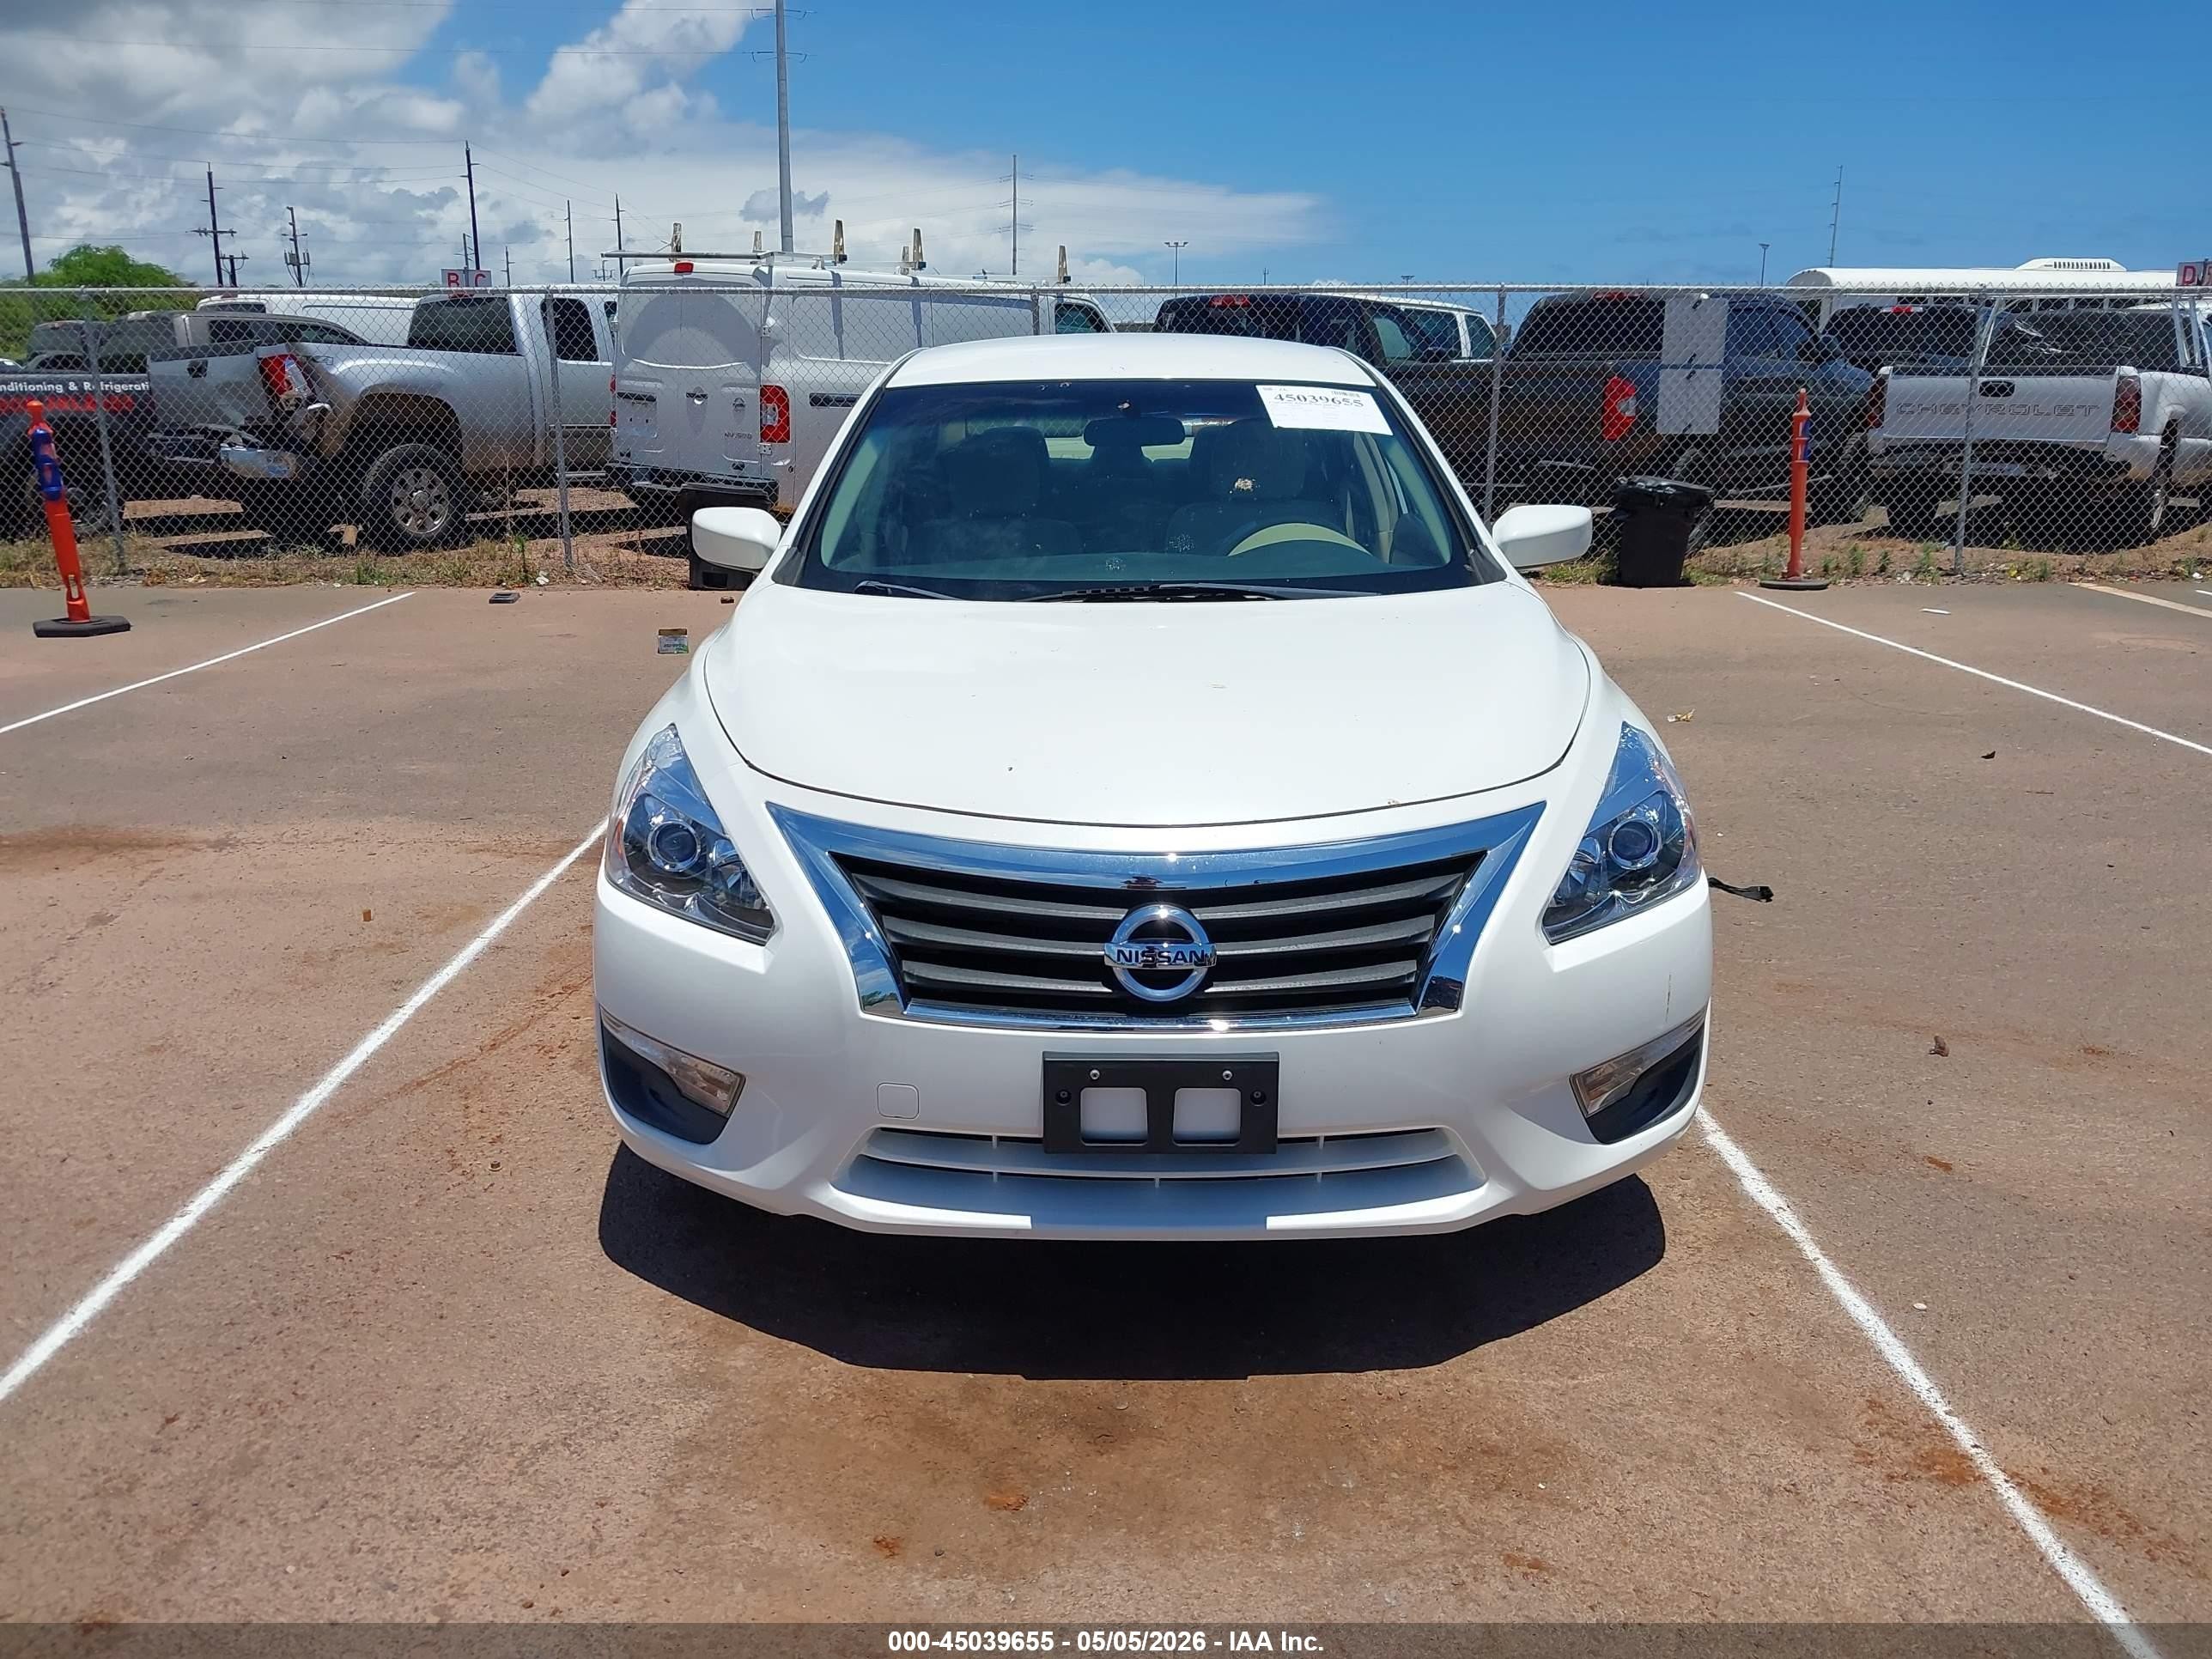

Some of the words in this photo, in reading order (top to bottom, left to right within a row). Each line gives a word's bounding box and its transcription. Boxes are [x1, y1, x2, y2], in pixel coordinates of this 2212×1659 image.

[2183, 266, 2197, 284] D
[68, 381, 78, 391] &
[1273, 393, 1364, 408] 45039655
[1896, 403, 2100, 416] CHEVROLET
[1116, 949, 1205, 963] NISSAN
